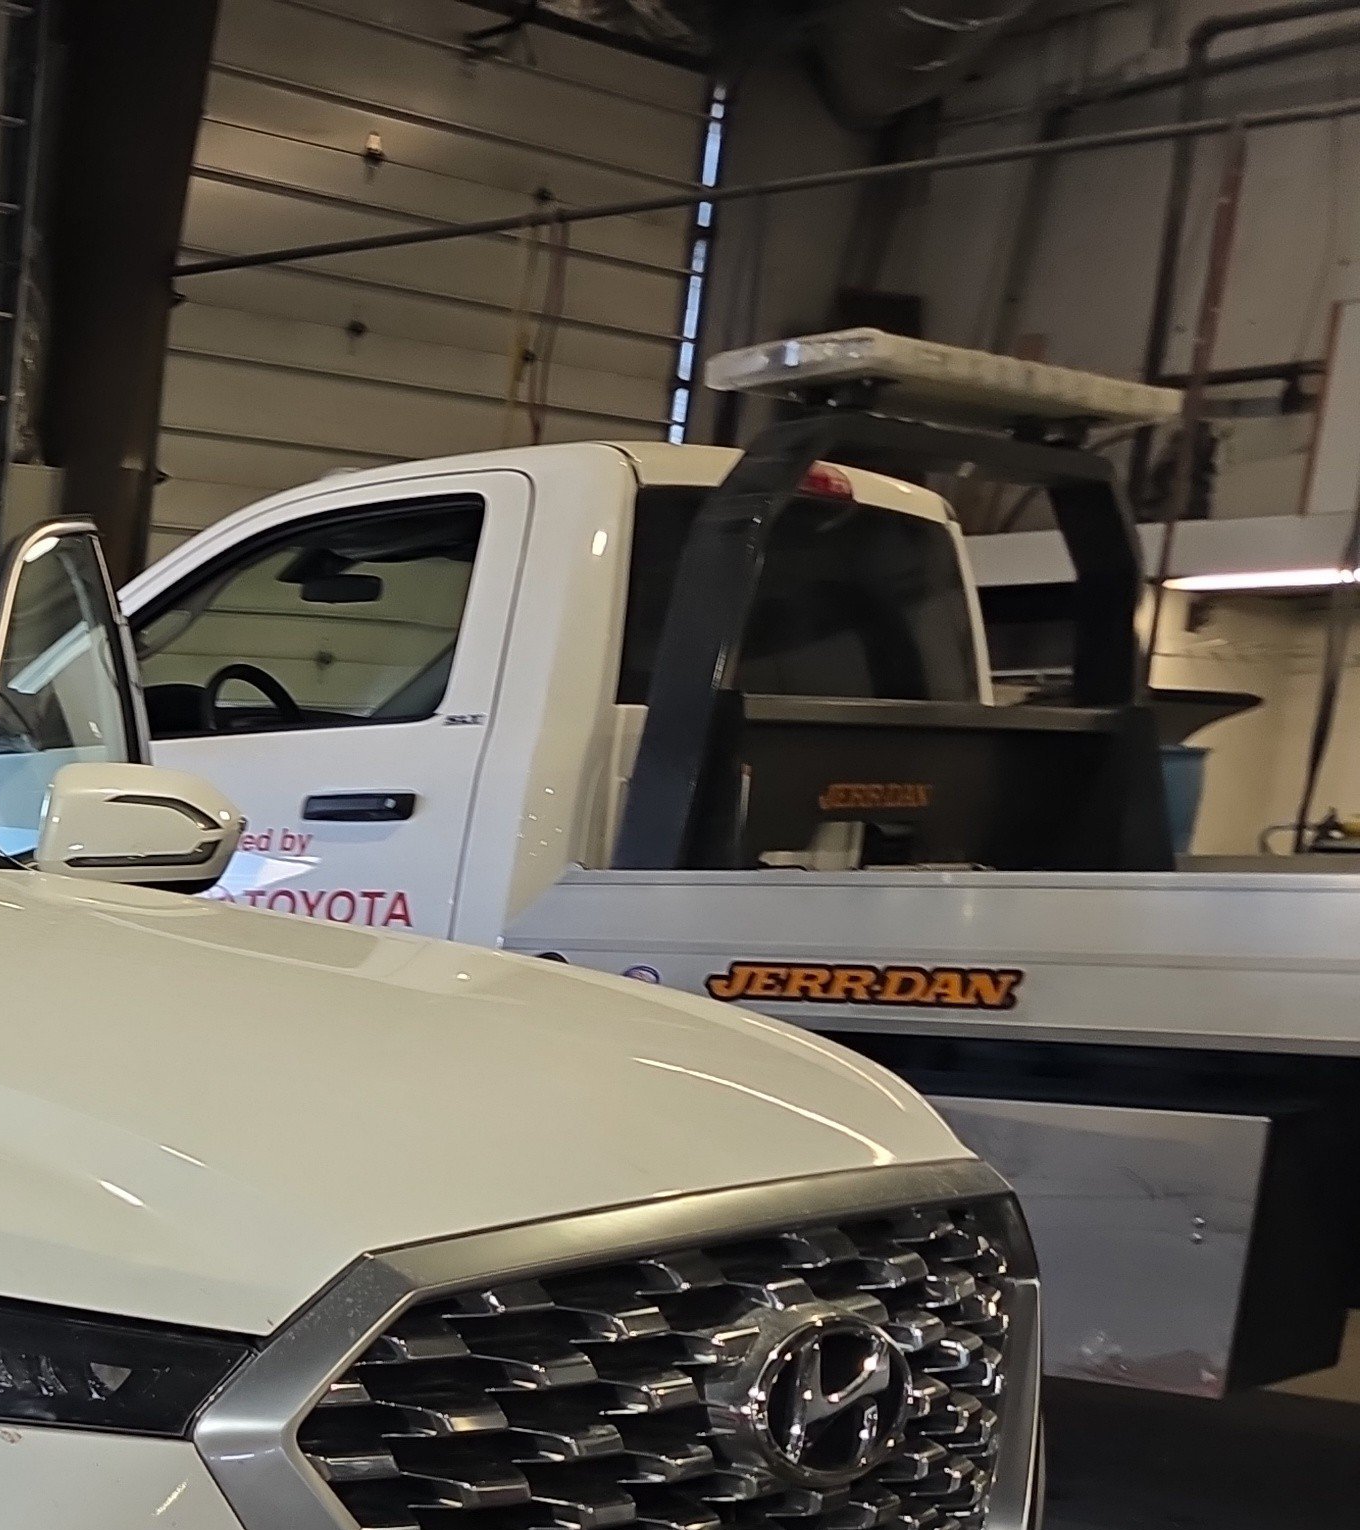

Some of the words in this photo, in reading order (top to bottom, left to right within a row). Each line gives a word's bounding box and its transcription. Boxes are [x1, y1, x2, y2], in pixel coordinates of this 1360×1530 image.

[238, 827, 272, 852] ed
[279, 827, 314, 857] by
[243, 889, 413, 927] TOYOTA
